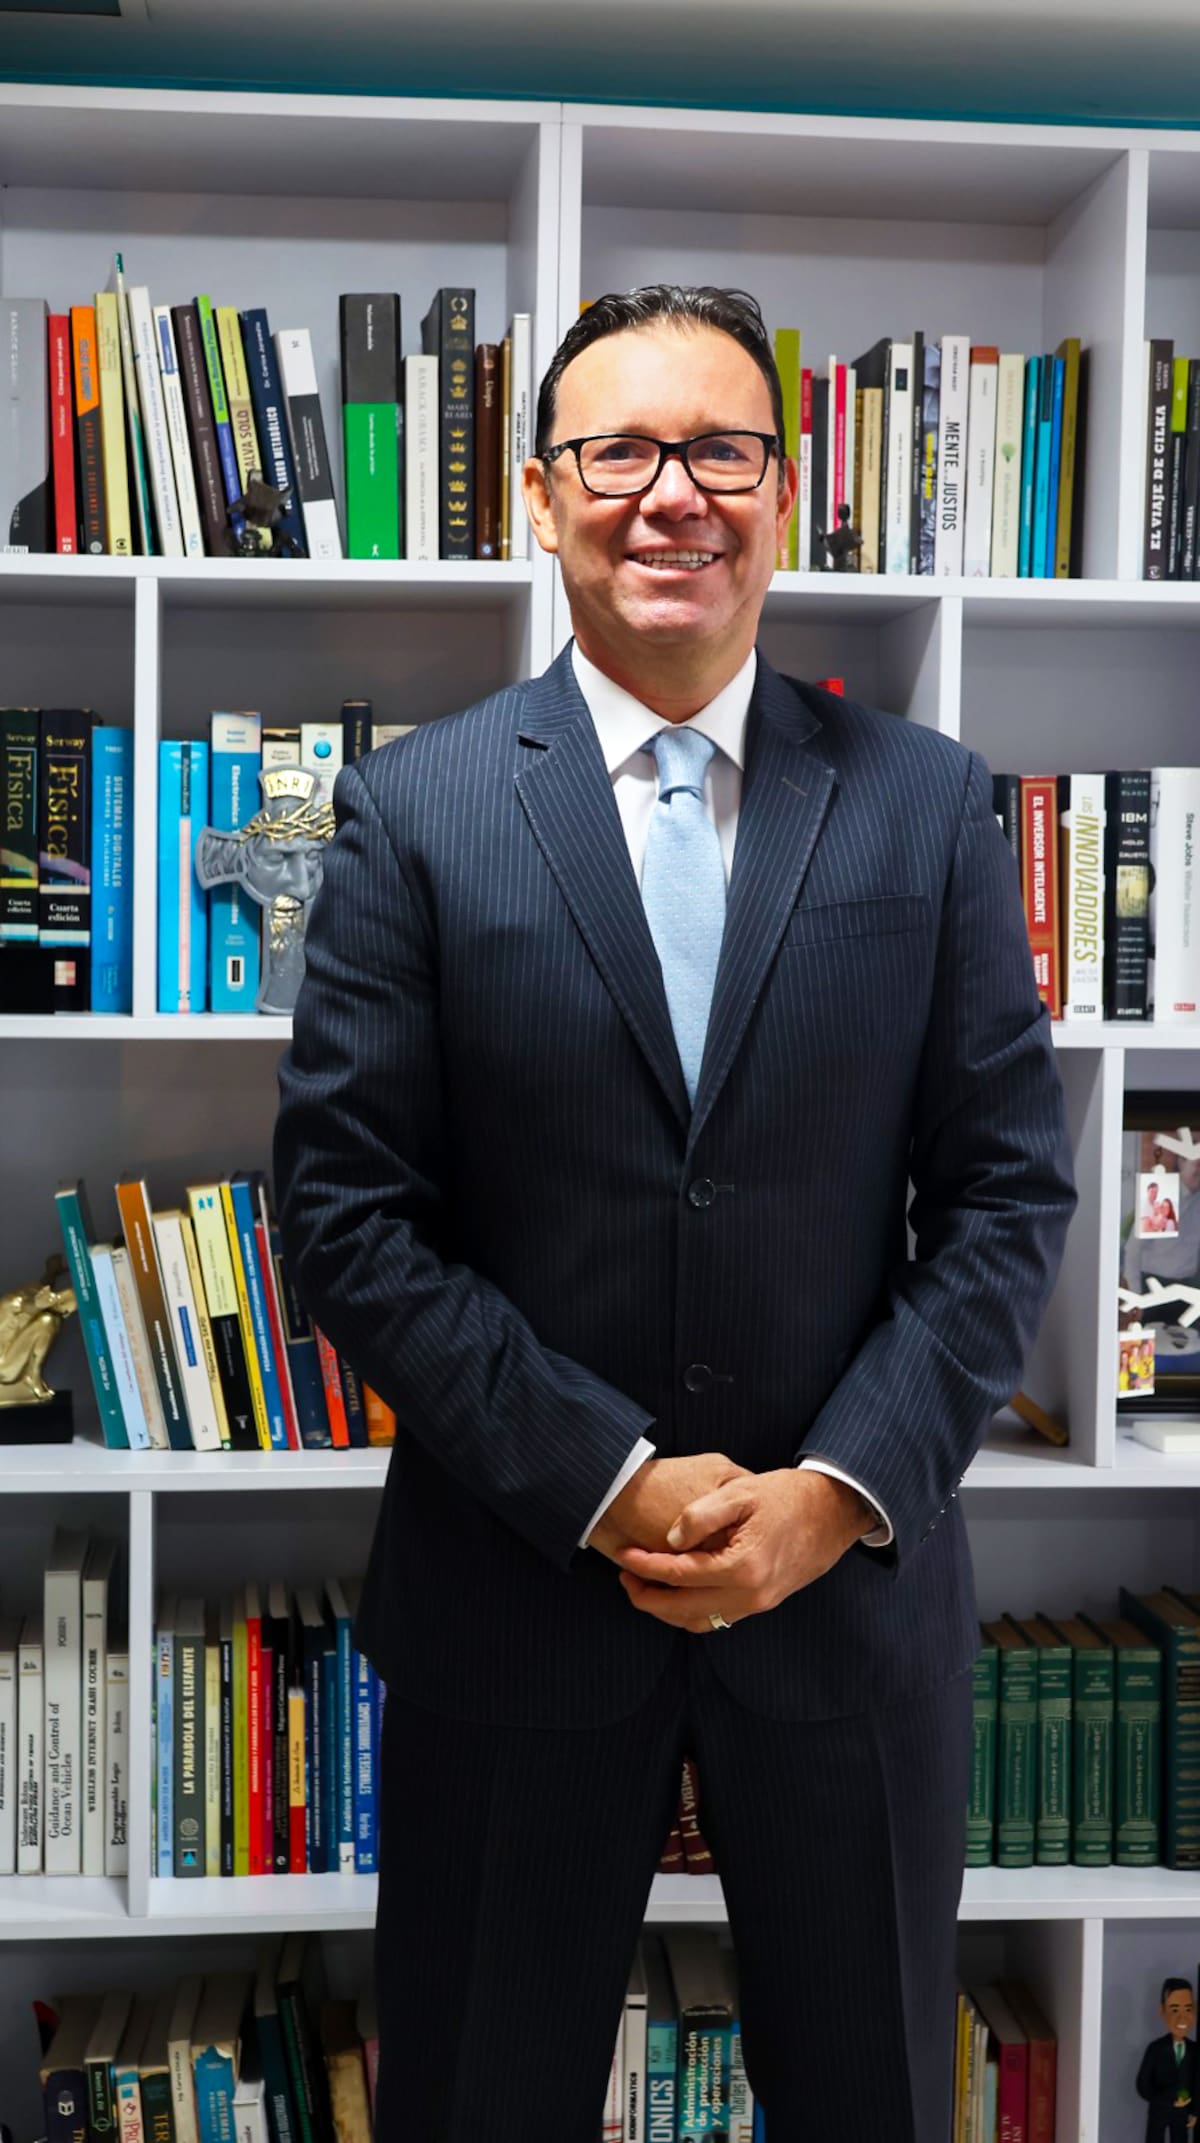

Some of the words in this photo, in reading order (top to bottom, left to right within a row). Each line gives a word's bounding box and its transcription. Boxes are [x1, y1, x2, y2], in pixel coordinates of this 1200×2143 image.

[444, 411, 473, 419] BEARD
[447, 403, 469, 411] MARY
[945, 422, 960, 468] MENTE
[1154, 405, 1166, 454] CILKA
[1154, 458, 1164, 480] DE
[942, 482, 958, 531] JUSTOS
[1151, 484, 1165, 528] VIAJE
[1151, 530, 1161, 550] EL
[46, 734, 86, 750] Serway
[7, 753, 32, 832] Física
[113, 776, 123, 829] SISTEMAS
[1032, 796, 1044, 808] EL
[47, 763, 78, 862] Física
[1120, 812, 1148, 823] IBM
[1185, 812, 1195, 841] Steve
[1033, 809, 1045, 860] INVERSOR
[112, 834, 122, 887] DIGITALES
[1184, 842, 1194, 867] Jobs
[49, 903, 79, 913] Cuarta
[1034, 861, 1046, 923] INTELIGENTE
[1074, 814, 1100, 963] INNOVADORES
[48, 912, 81, 923] edición
[88, 1648, 97, 1684] COURSE
[182, 1647, 195, 1697] ELEFANTE
[48, 1703, 59, 1714] of
[88, 1686, 97, 1717] CRASH
[182, 1699, 194, 1719] DEL
[48, 1718, 60, 1760] Control
[88, 1719, 97, 1766] INTERNET
[182, 1722, 195, 1778] PARABOLA
[48, 1763, 59, 1784] and
[60, 1753, 72, 1798] Vehicles
[88, 1768, 97, 1813] WIRELESS
[183, 1781, 195, 1794] LA
[342, 1785, 352, 1797] de
[48, 1787, 61, 1839] Guidance
[61, 1801, 72, 1837] Ocean
[342, 1799, 352, 1832] Análisis
[683, 2031, 697, 2128] Administración
[696, 2036, 711, 2107] producción
[710, 2037, 724, 2114] operaciones
[216, 2090, 230, 2141] SISTEMAS
[696, 2110, 707, 2127] de
[711, 2118, 723, 2127] y
